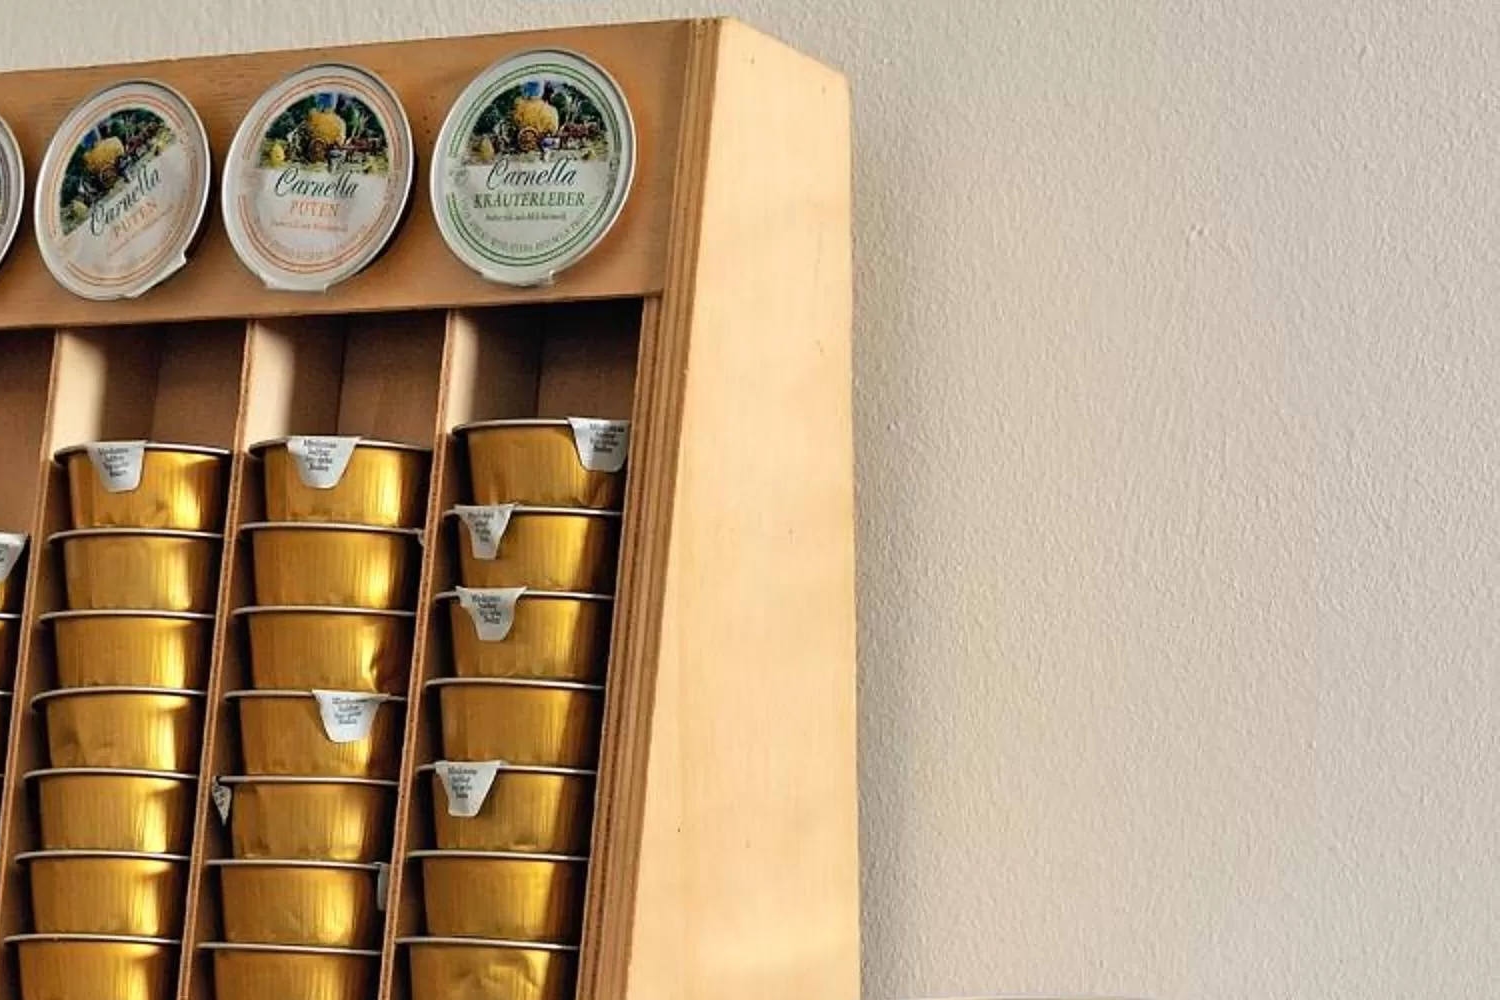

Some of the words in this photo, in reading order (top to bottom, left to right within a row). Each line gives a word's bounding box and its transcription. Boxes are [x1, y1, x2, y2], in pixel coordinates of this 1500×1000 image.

[274, 166, 359, 198] Carnella
[486, 155, 577, 190] Carnella
[90, 163, 161, 237] Carnella
[290, 200, 341, 217] PUTEN
[112, 200, 158, 238] PUTEN
